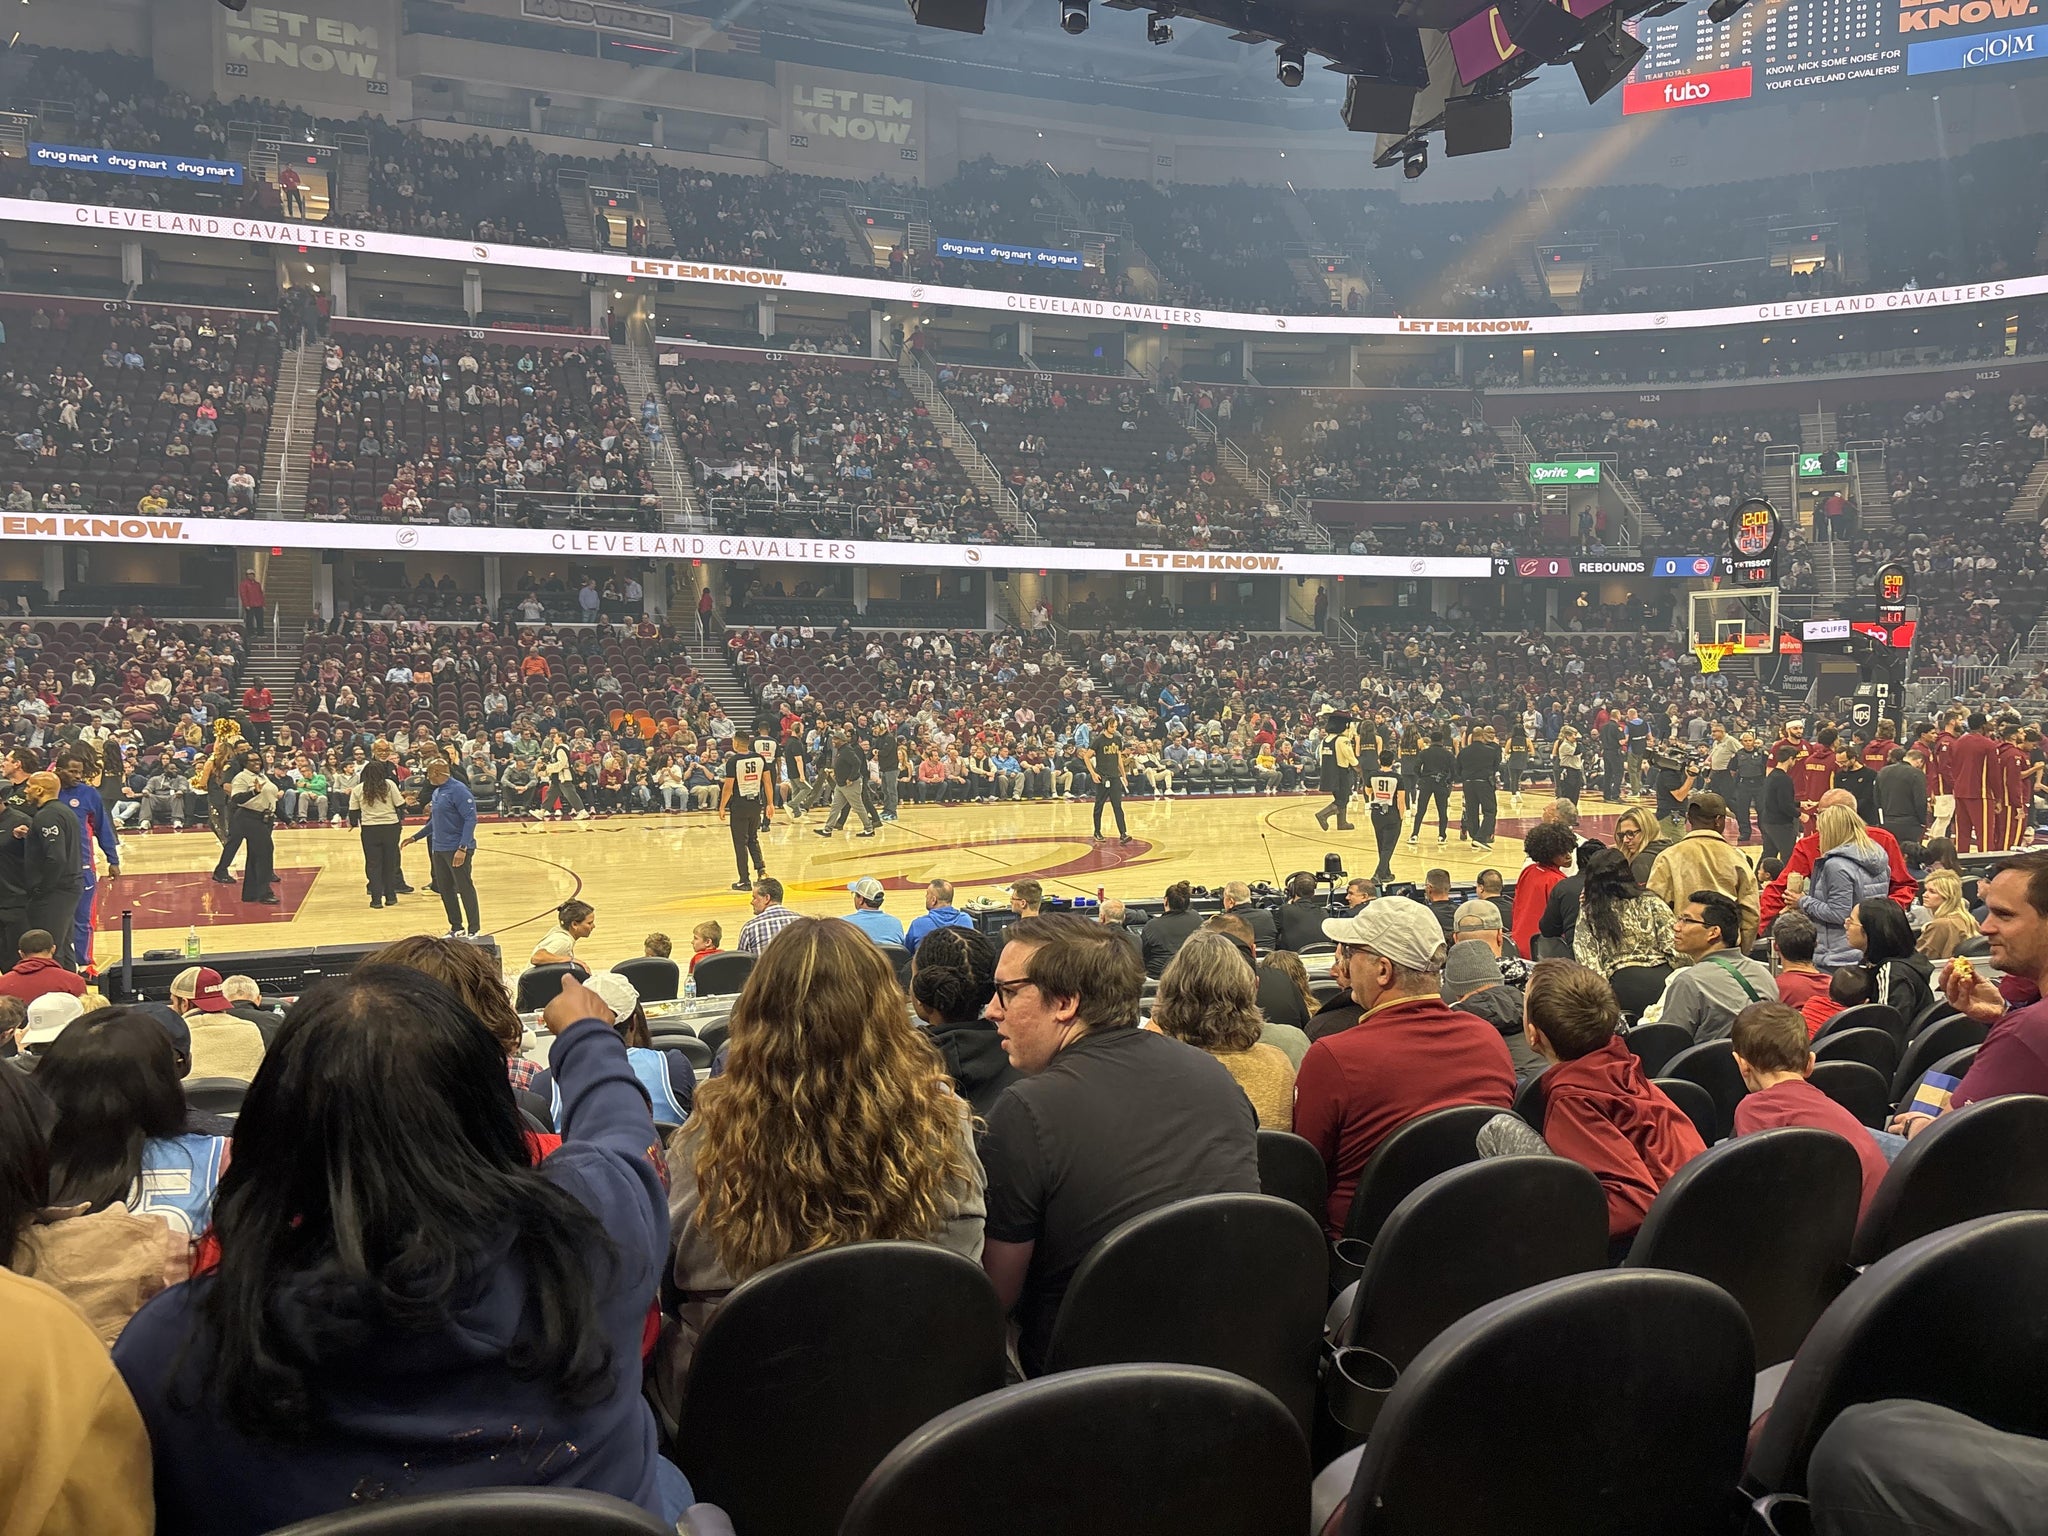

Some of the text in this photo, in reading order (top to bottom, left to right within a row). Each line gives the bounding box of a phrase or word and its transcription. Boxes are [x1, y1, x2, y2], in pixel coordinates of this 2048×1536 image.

[1899, 0, 2038, 32] KNOW.
[226, 8, 378, 49] LET EM
[1656, 33, 1676, 42] Merrill
[226, 32, 386, 80] KNOW.
[1656, 58, 1680, 67] Mitchell
[1797, 60, 1819, 71] NICK
[1821, 57, 1848, 68] SOME
[1850, 52, 1879, 64] NOISE
[1881, 49, 1900, 59] FOR
[226, 64, 247, 75] 222
[1644, 72, 1663, 80] TEAM
[1665, 68, 1691, 77] TOTALS
[1766, 65, 1899, 90] YOUR CLEVELAND CAVALIERS!
[368, 83, 388, 93] 223
[1664, 82, 1710, 102] fubo
[792, 85, 913, 118] LET EM
[792, 110, 916, 145] KNOW.
[791, 136, 808, 147] 224
[38, 148, 235, 177] drug mart drug mart drug mart
[902, 150, 917, 160] 225
[595, 190, 608, 198] 223
[76, 208, 365, 247] CLEVELAND CAVALIERS
[942, 242, 1078, 265] drug mart drug mart drug mart
[631, 260, 787, 286] LET EM KNOW.
[1759, 284, 2005, 319] CLEVELAND CAVALIERS
[1007, 296, 1202, 324] CLEVELAND CAVALIERS
[1398, 320, 1533, 332] LET EM KNOW.
[1533, 467, 1569, 480] Sprite
[1742, 511, 1768, 526] 12:00
[3, 517, 188, 539] EM KNOW.
[1740, 525, 1766, 551] 24
[552, 533, 856, 559] CLEVELAND CAVALIERS
[1125, 553, 1283, 570] LET EM KNOW.
[1498, 566, 1505, 575] 0
[1549, 562, 1558, 574] 0
[1579, 563, 1645, 573] REBOUNDS
[1666, 561, 1676, 573] 0
[1745, 559, 1771, 567] TISSOT
[1884, 586, 1899, 598] 24
[1821, 625, 1847, 633] CLIFFS
[1855, 711, 1869, 723] ups
[762, 742, 770, 751] 19
[745, 762, 756, 773] 56
[1378, 780, 1388, 792] 91
